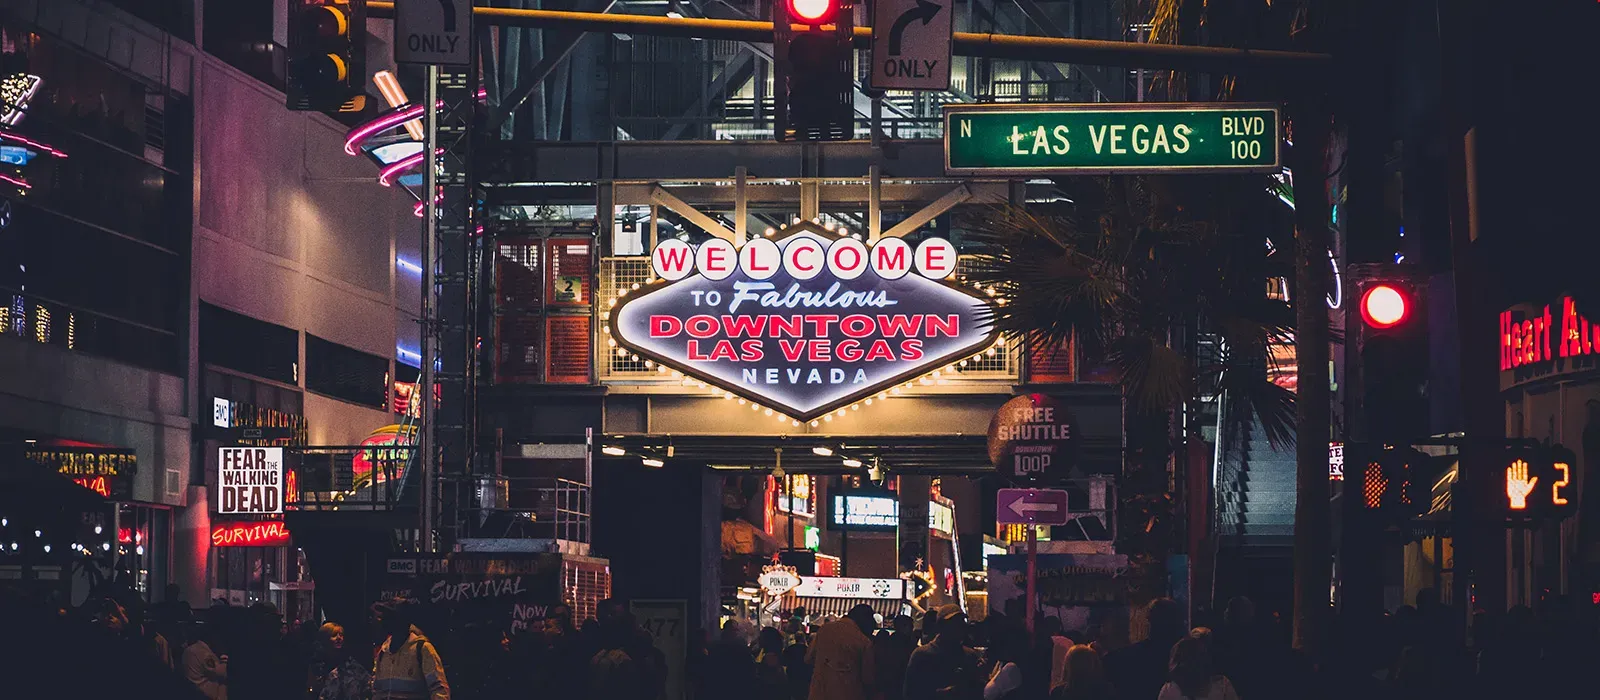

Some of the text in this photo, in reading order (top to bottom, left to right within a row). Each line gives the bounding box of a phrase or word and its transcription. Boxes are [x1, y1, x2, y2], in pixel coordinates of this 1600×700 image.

[408, 33, 460, 54] ONLY
[884, 58, 938, 79] ONLY
[960, 119, 972, 138] N
[1221, 116, 1265, 137] BLVD
[1012, 124, 1191, 155] LAS VEGAS
[1230, 140, 1261, 160] 100
[657, 245, 946, 272] WELCOME
[565, 280, 573, 291] 2
[690, 280, 898, 314] TO Fabulous
[649, 314, 960, 338] DOWNTOWN
[1499, 303, 1552, 371] Heart
[686, 339, 924, 362] LAS VEGAS
[742, 368, 869, 384] NEVADA
[1014, 407, 1054, 423] FREE
[998, 424, 1070, 440] SHUTTLE
[223, 449, 278, 470] FEAR THE
[223, 471, 278, 485] WALKING
[1552, 462, 1570, 505] 2
[223, 486, 278, 512] DEAD
[212, 522, 289, 545] SURVIVAL
[420, 559, 449, 574] FEAR
[430, 575, 527, 604] SURVIVAL
[769, 577, 789, 586] POKER
[836, 583, 861, 592] POKER
